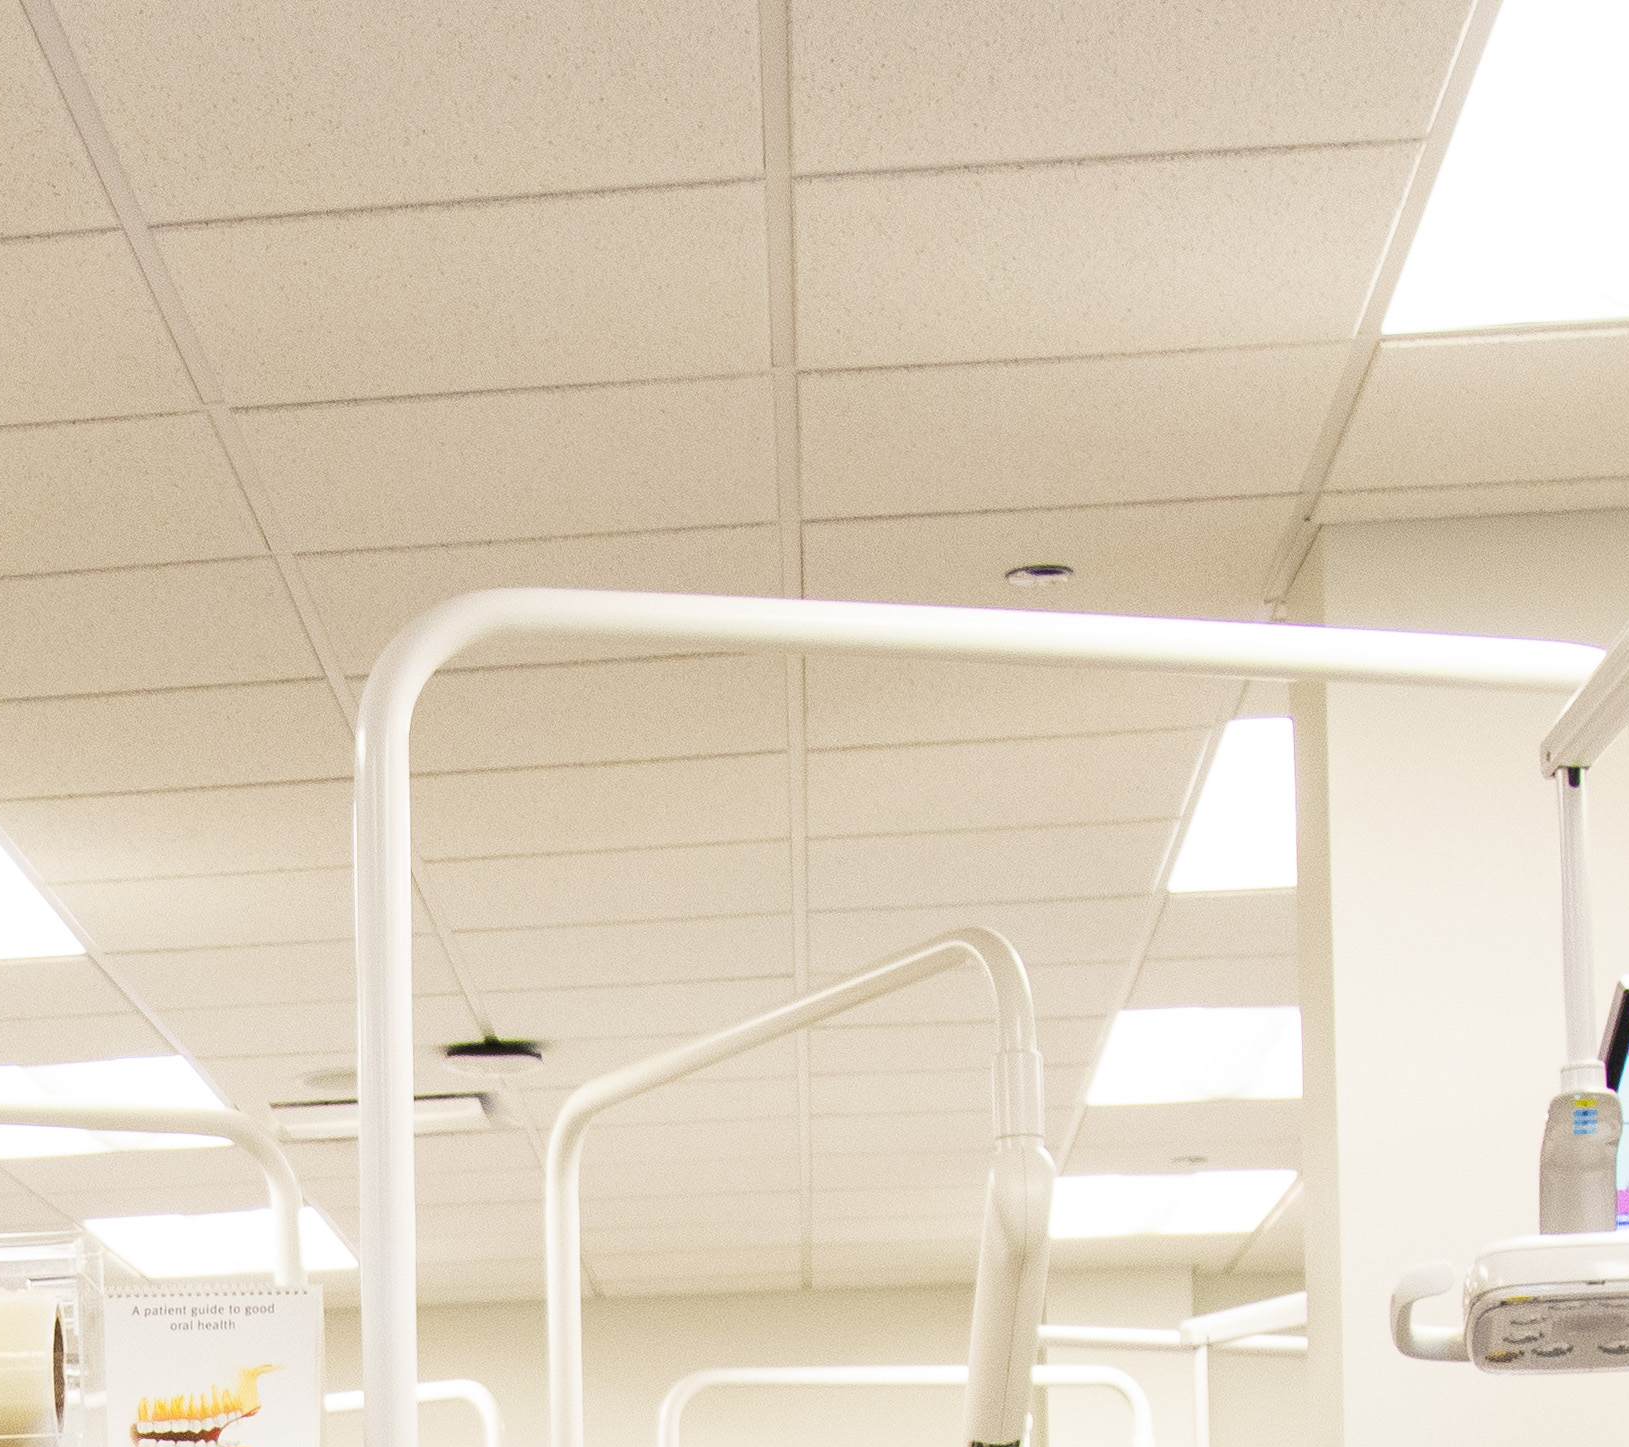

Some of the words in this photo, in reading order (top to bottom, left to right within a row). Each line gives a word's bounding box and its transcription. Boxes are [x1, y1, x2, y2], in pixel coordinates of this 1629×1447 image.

[132, 1306, 140, 1316] A
[144, 1305, 187, 1317] patient
[191, 1304, 225, 1316] guide
[229, 1305, 241, 1315] to
[245, 1303, 275, 1316] good
[170, 1320, 193, 1331] oral
[197, 1319, 236, 1331] health
